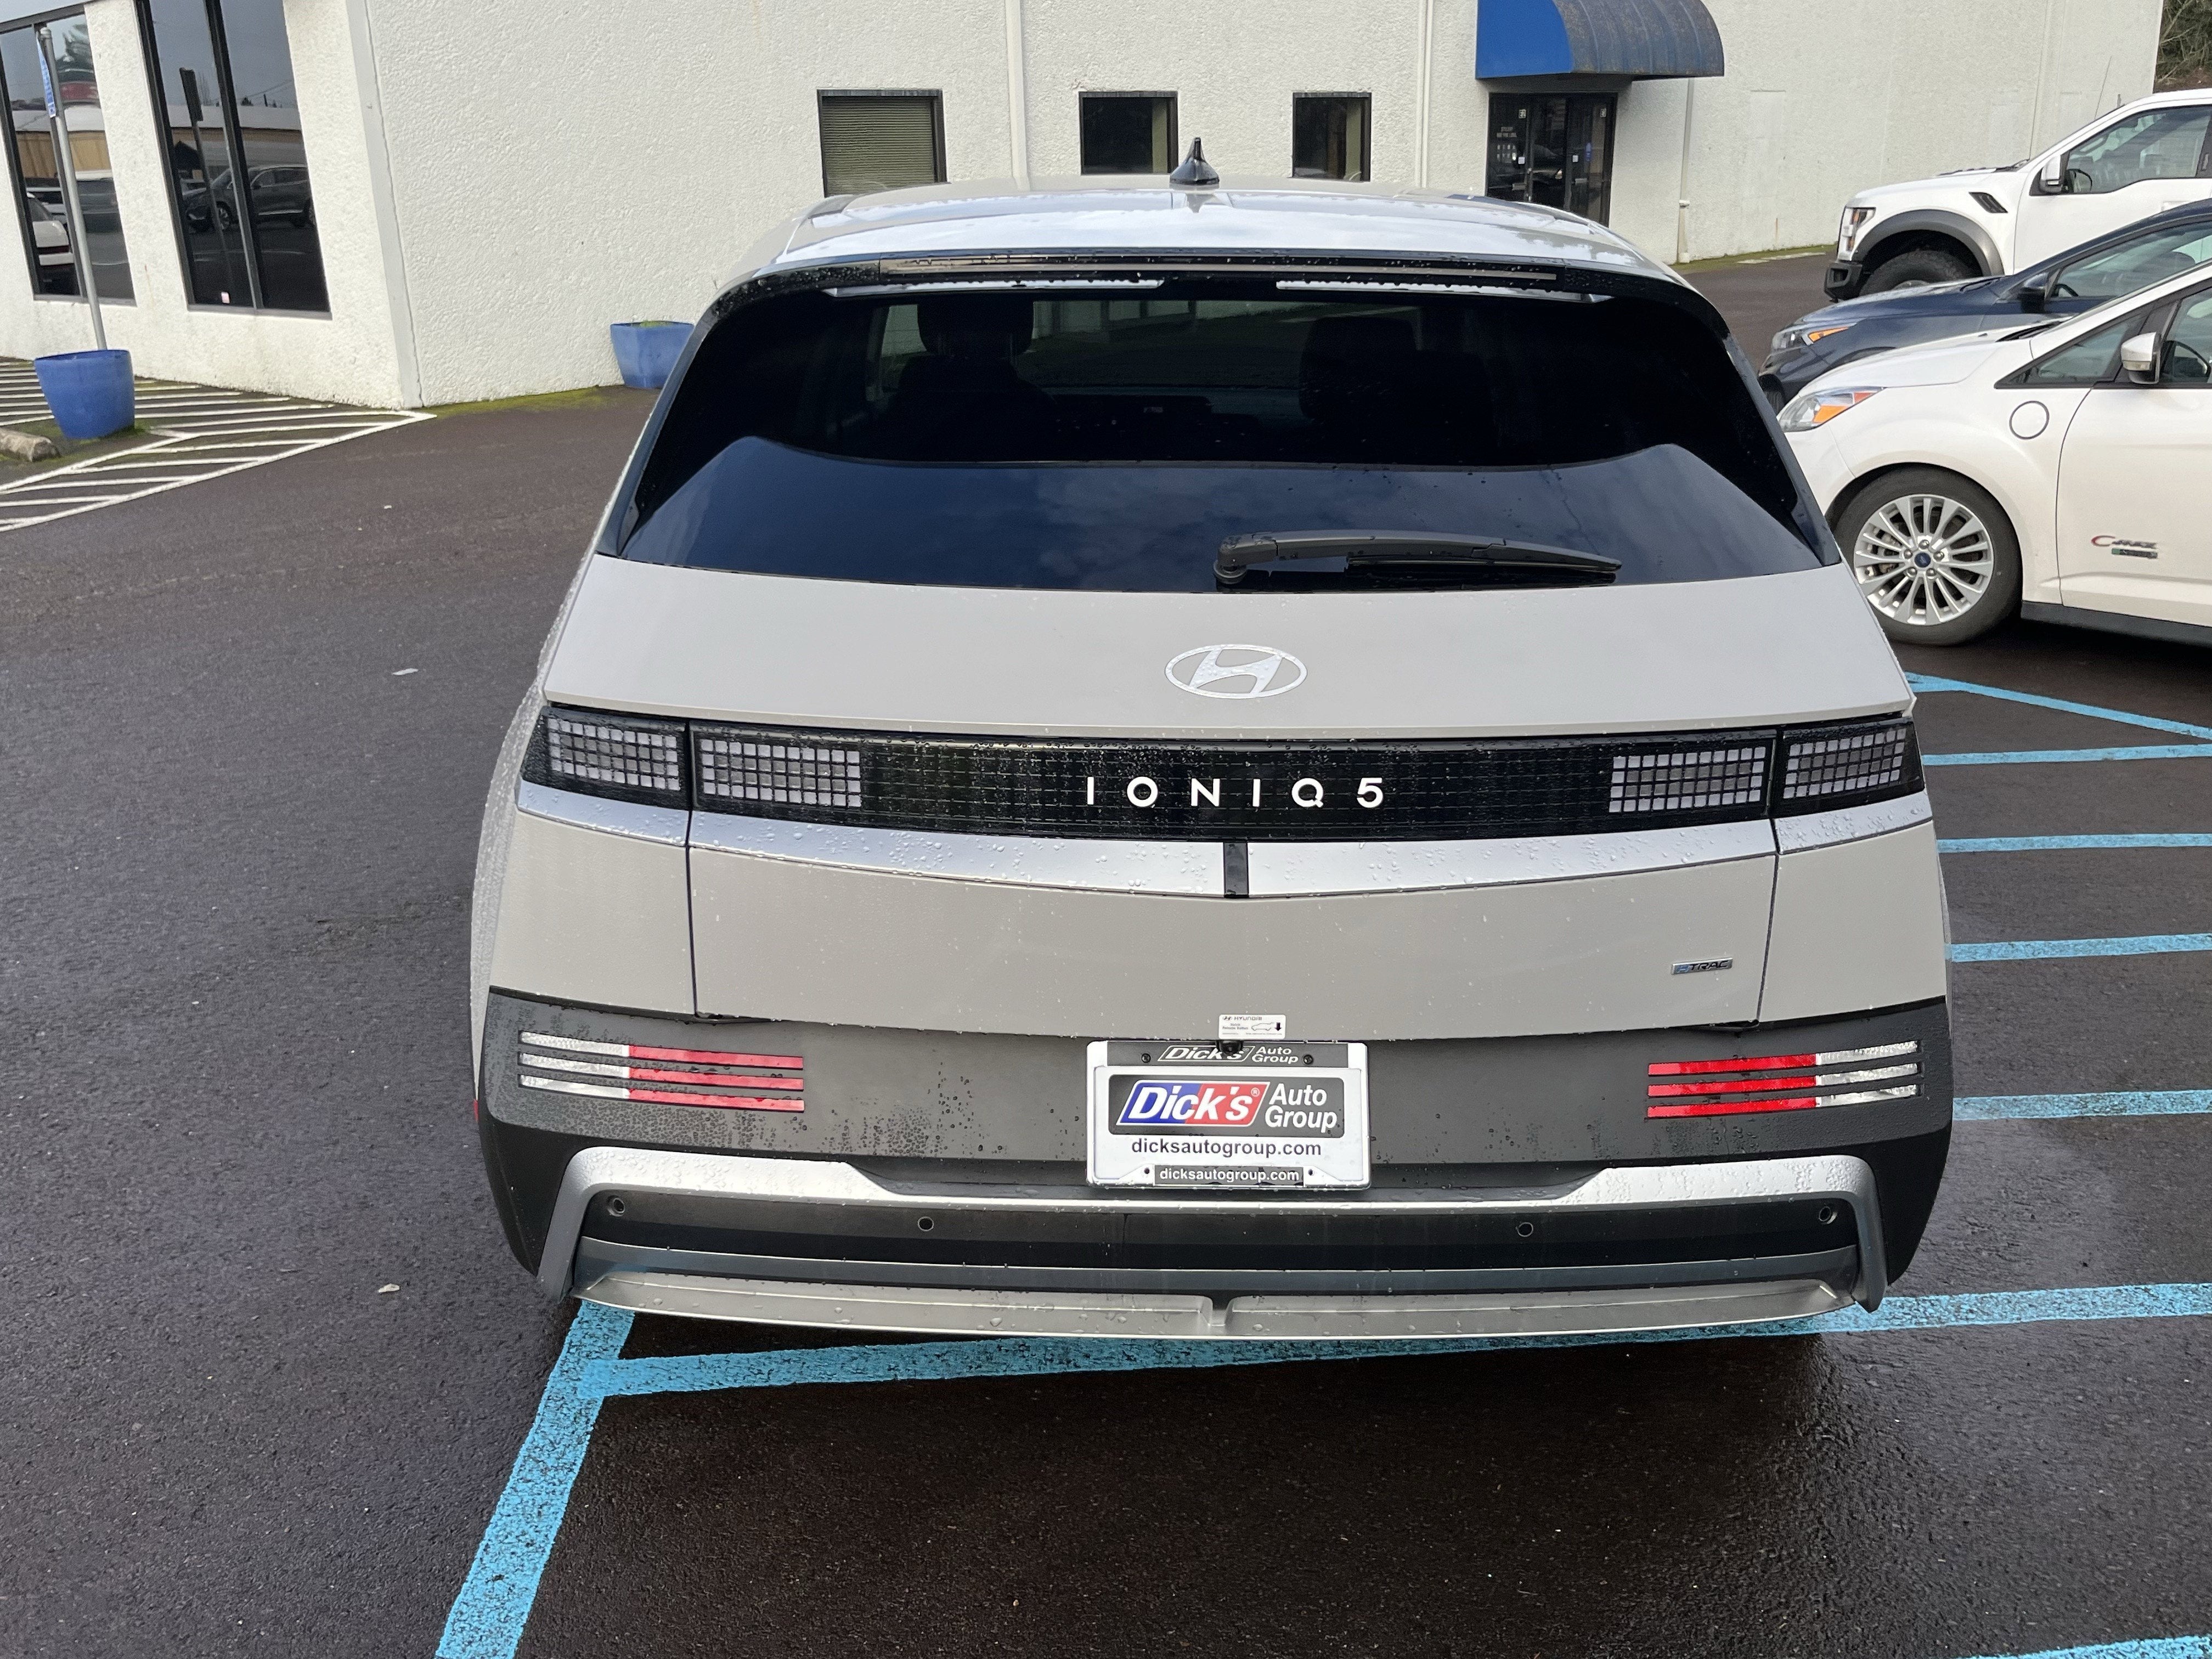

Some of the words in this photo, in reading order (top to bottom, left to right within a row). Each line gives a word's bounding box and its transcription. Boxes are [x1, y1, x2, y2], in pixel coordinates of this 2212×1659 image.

[1086, 776, 1324, 808] IONIQ
[1356, 777, 1384, 808] 5
[1165, 1047, 1244, 1060] Dicks
[1251, 1054, 1299, 1064] Group
[1256, 1046, 1292, 1056] Auto
[1128, 1085, 1254, 1120] Dick's
[1269, 1083, 1327, 1107] Auto
[1265, 1105, 1338, 1133] Group
[1131, 1138, 1322, 1158] dicksautogroup.com
[1159, 1167, 1299, 1183] dicksautogroup.com
